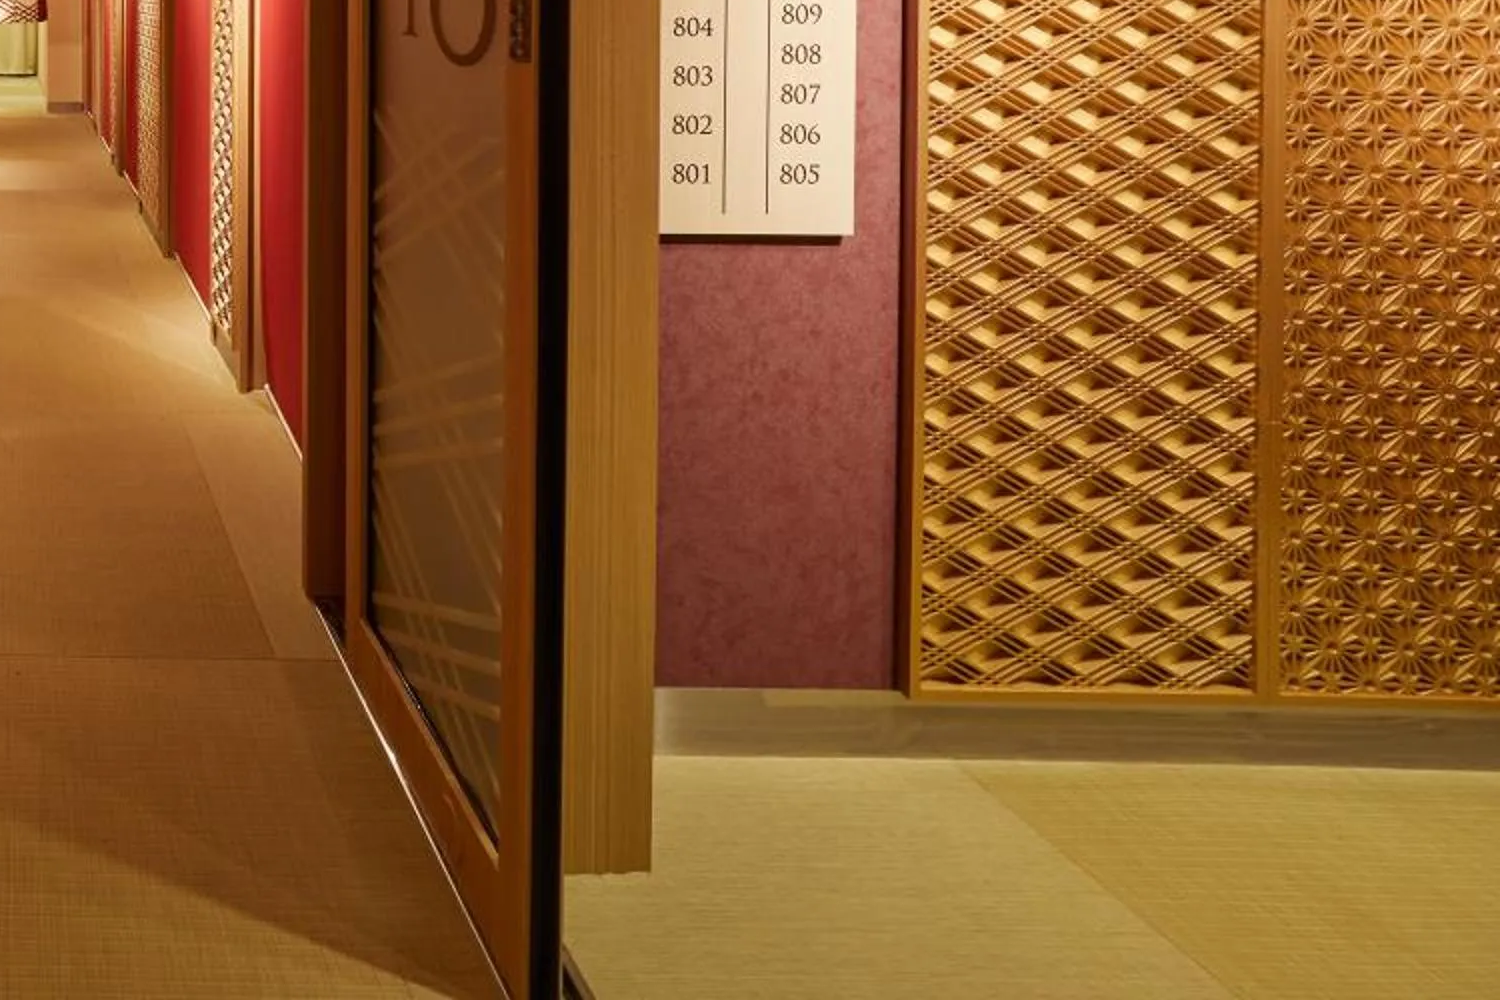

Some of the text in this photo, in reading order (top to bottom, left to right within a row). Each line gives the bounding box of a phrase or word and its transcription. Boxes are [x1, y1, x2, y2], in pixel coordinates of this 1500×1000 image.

[781, 3, 823, 25] 809
[672, 16, 714, 38] 804
[781, 43, 822, 65] 808
[672, 65, 714, 87] 803
[780, 83, 821, 105] 807
[671, 114, 713, 135] 802
[779, 123, 822, 145] 806
[671, 163, 712, 185] 801
[779, 163, 821, 185] 805
